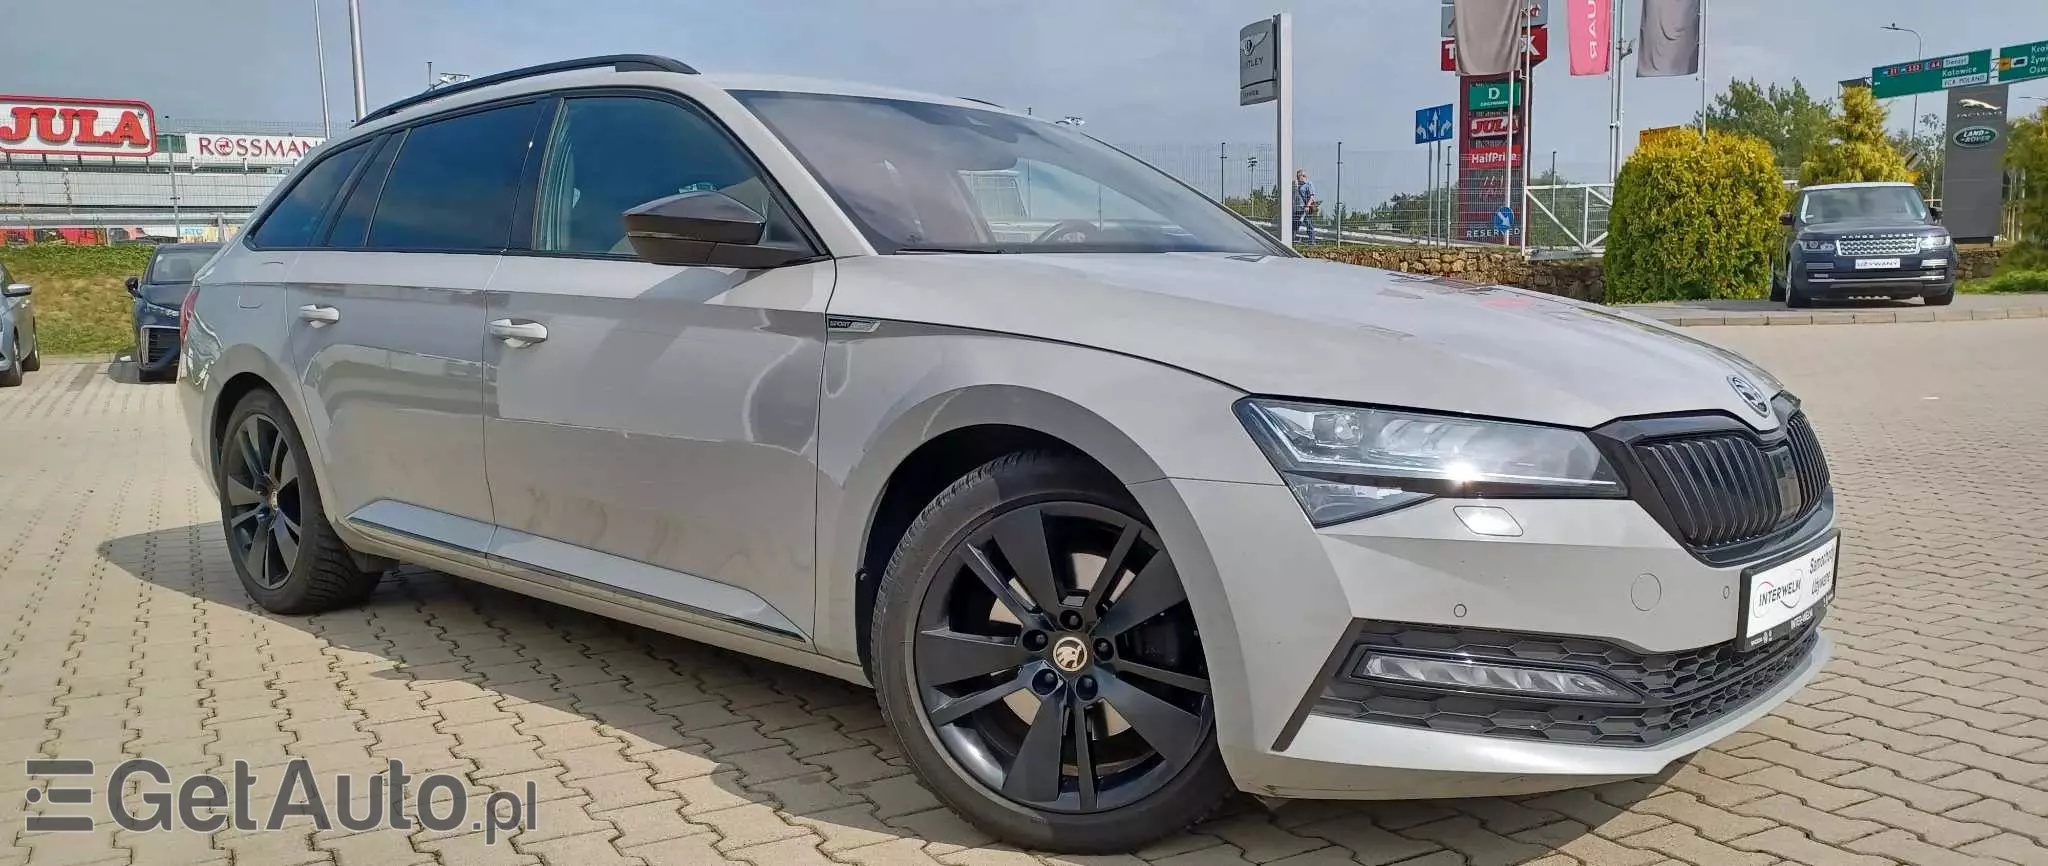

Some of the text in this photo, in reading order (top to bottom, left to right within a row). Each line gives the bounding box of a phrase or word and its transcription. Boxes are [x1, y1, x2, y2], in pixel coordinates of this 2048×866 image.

[1942, 66, 1977, 77] Katowice
[1488, 87, 1500, 99] D
[0, 106, 149, 146] JULA
[1472, 153, 1517, 163] HalfPrie
